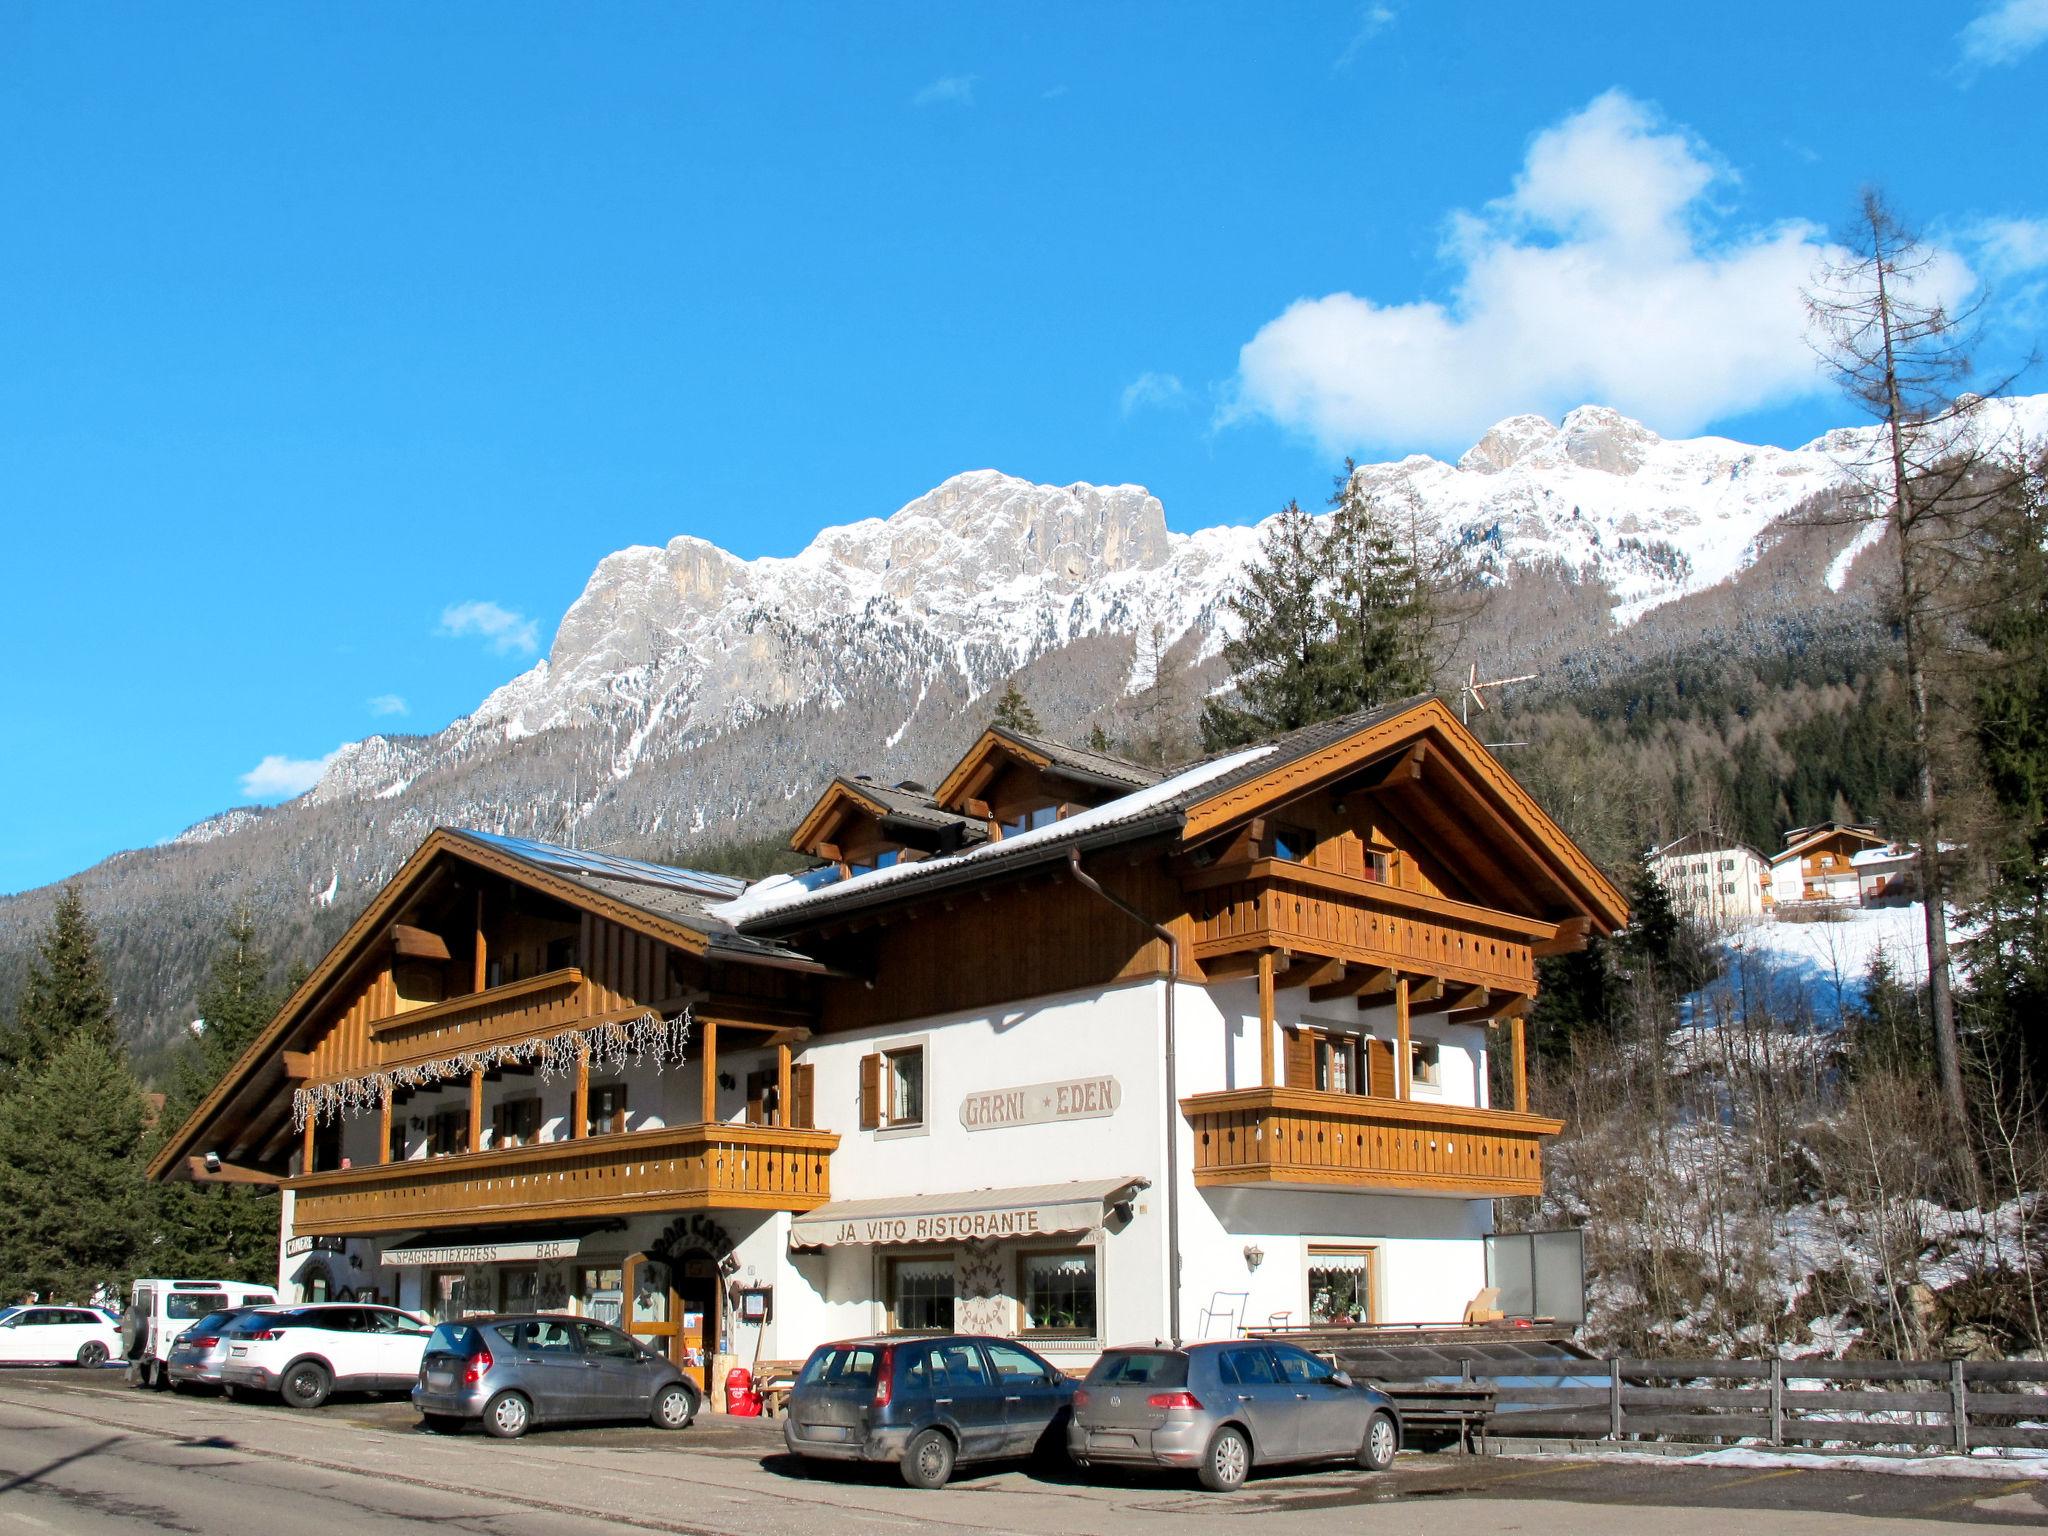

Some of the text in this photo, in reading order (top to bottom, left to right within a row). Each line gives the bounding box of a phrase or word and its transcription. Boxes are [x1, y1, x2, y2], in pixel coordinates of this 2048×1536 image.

[966, 1080, 1113, 1126] GARNI EDEN
[836, 1210, 1039, 1242] JA VITO RISTORANTE
[536, 1242, 560, 1259] BAR
